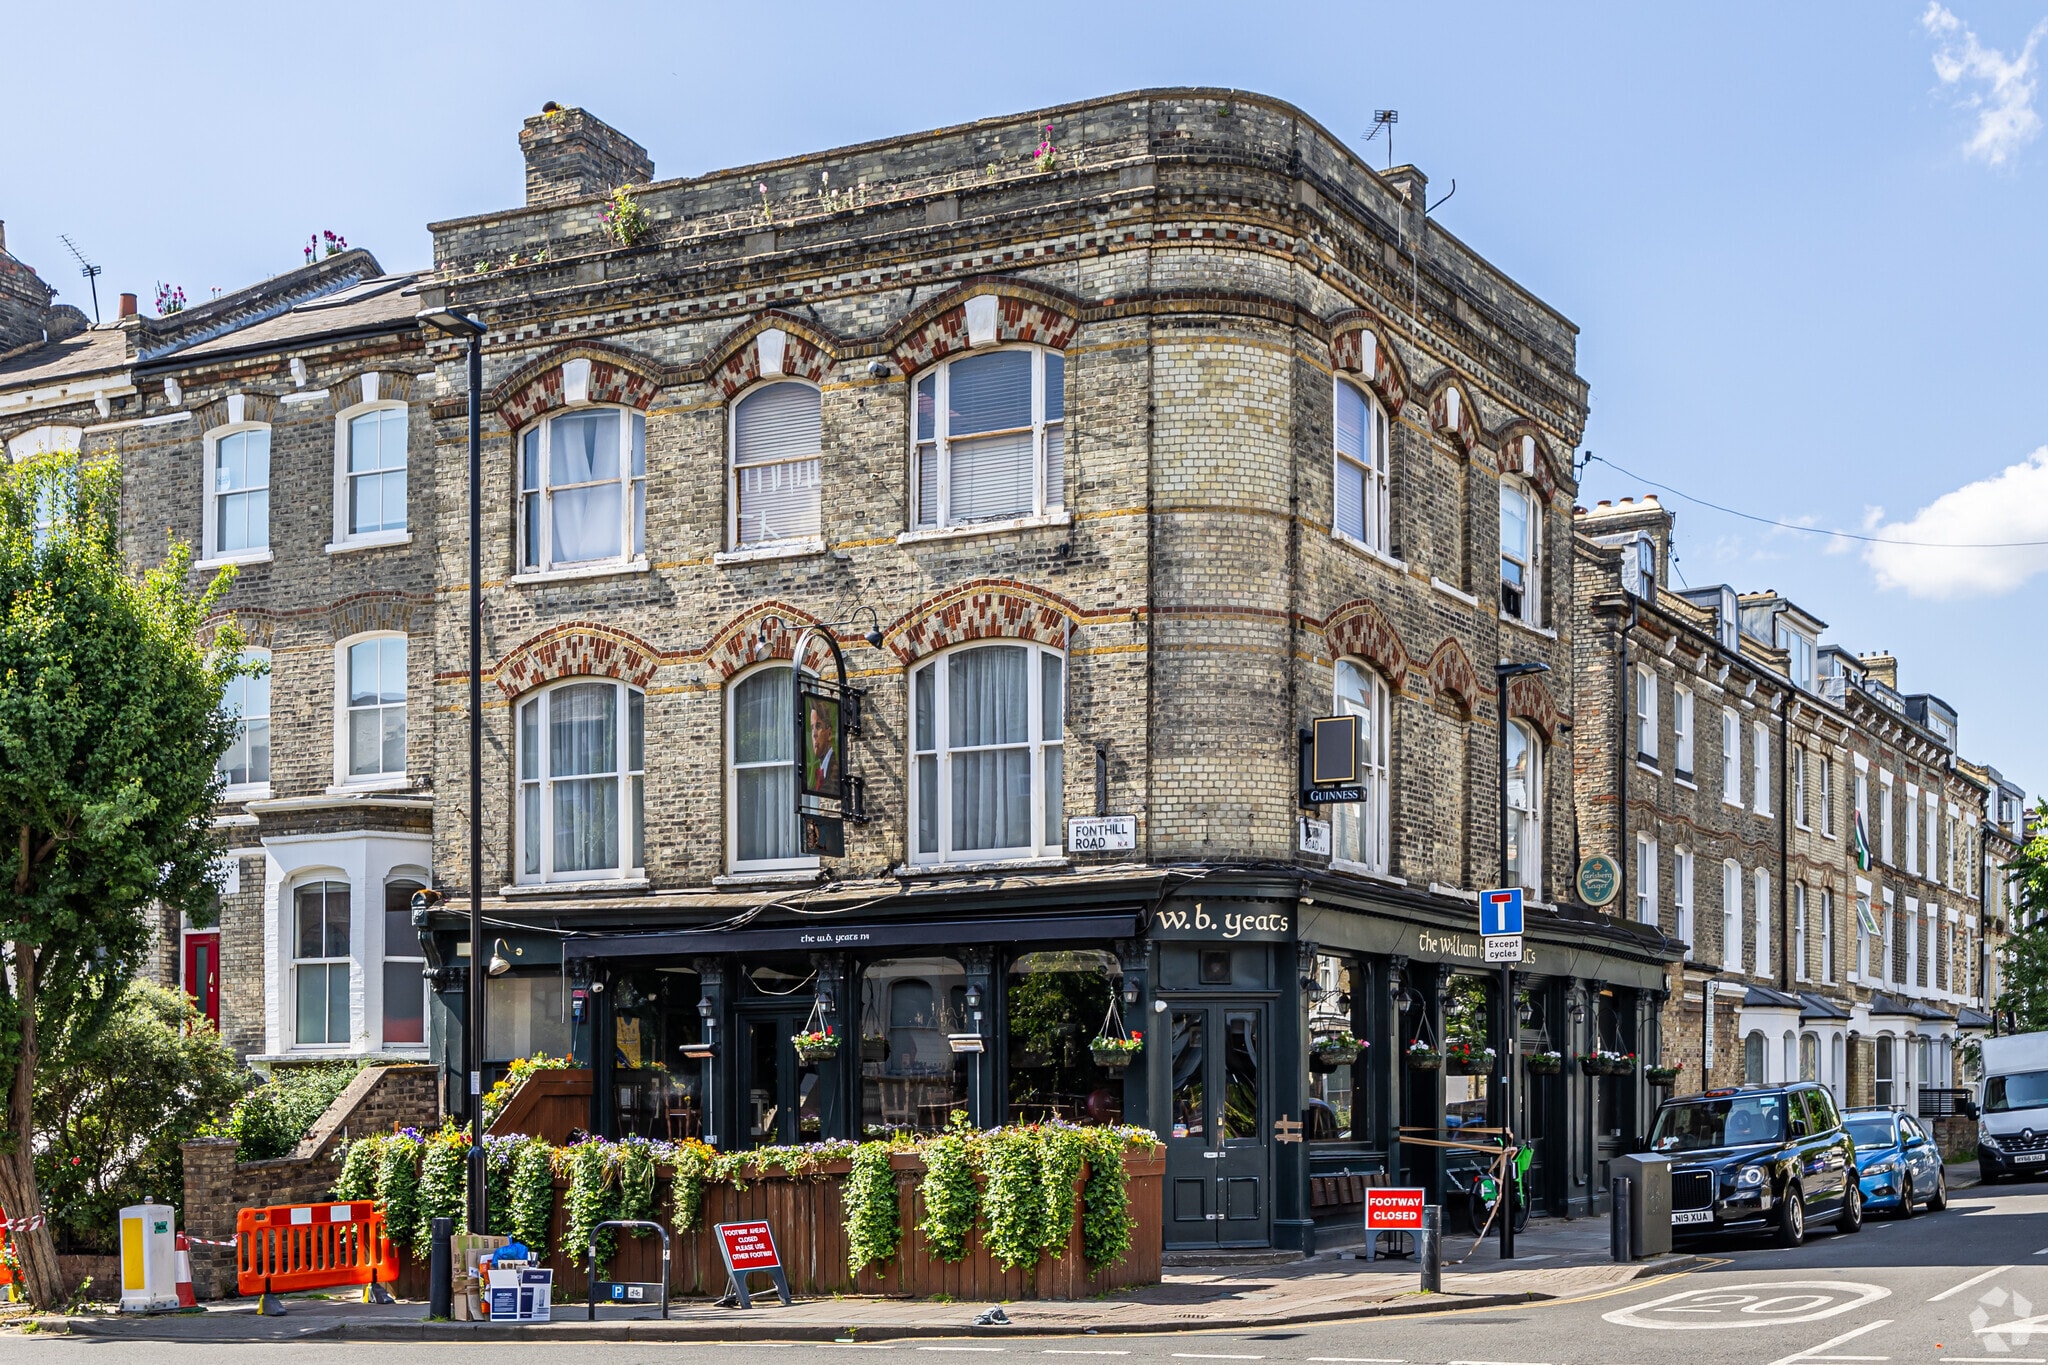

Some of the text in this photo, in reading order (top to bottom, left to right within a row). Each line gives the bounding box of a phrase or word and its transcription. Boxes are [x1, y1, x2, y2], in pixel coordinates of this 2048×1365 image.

[1310, 790, 1359, 801] GUINNESS
[1075, 823, 1128, 837] FONTHILL
[1075, 837, 1106, 850] ROAD
[1581, 870, 1613, 881] Carlsberg
[1587, 883, 1608, 892] Lager
[1156, 903, 1289, 939] w.b. yeats
[1419, 930, 1438, 953] The
[1440, 935, 1477, 958] William
[1488, 939, 1519, 949] Except
[1489, 949, 1517, 959] cycles
[1369, 1197, 1421, 1206] FOOTWAY
[1373, 1211, 1417, 1220] CLOSED
[1671, 1212, 1708, 1223] N19 XUA
[732, 1252, 749, 1260] OTHER
[1653, 1294, 1834, 1313] 20
